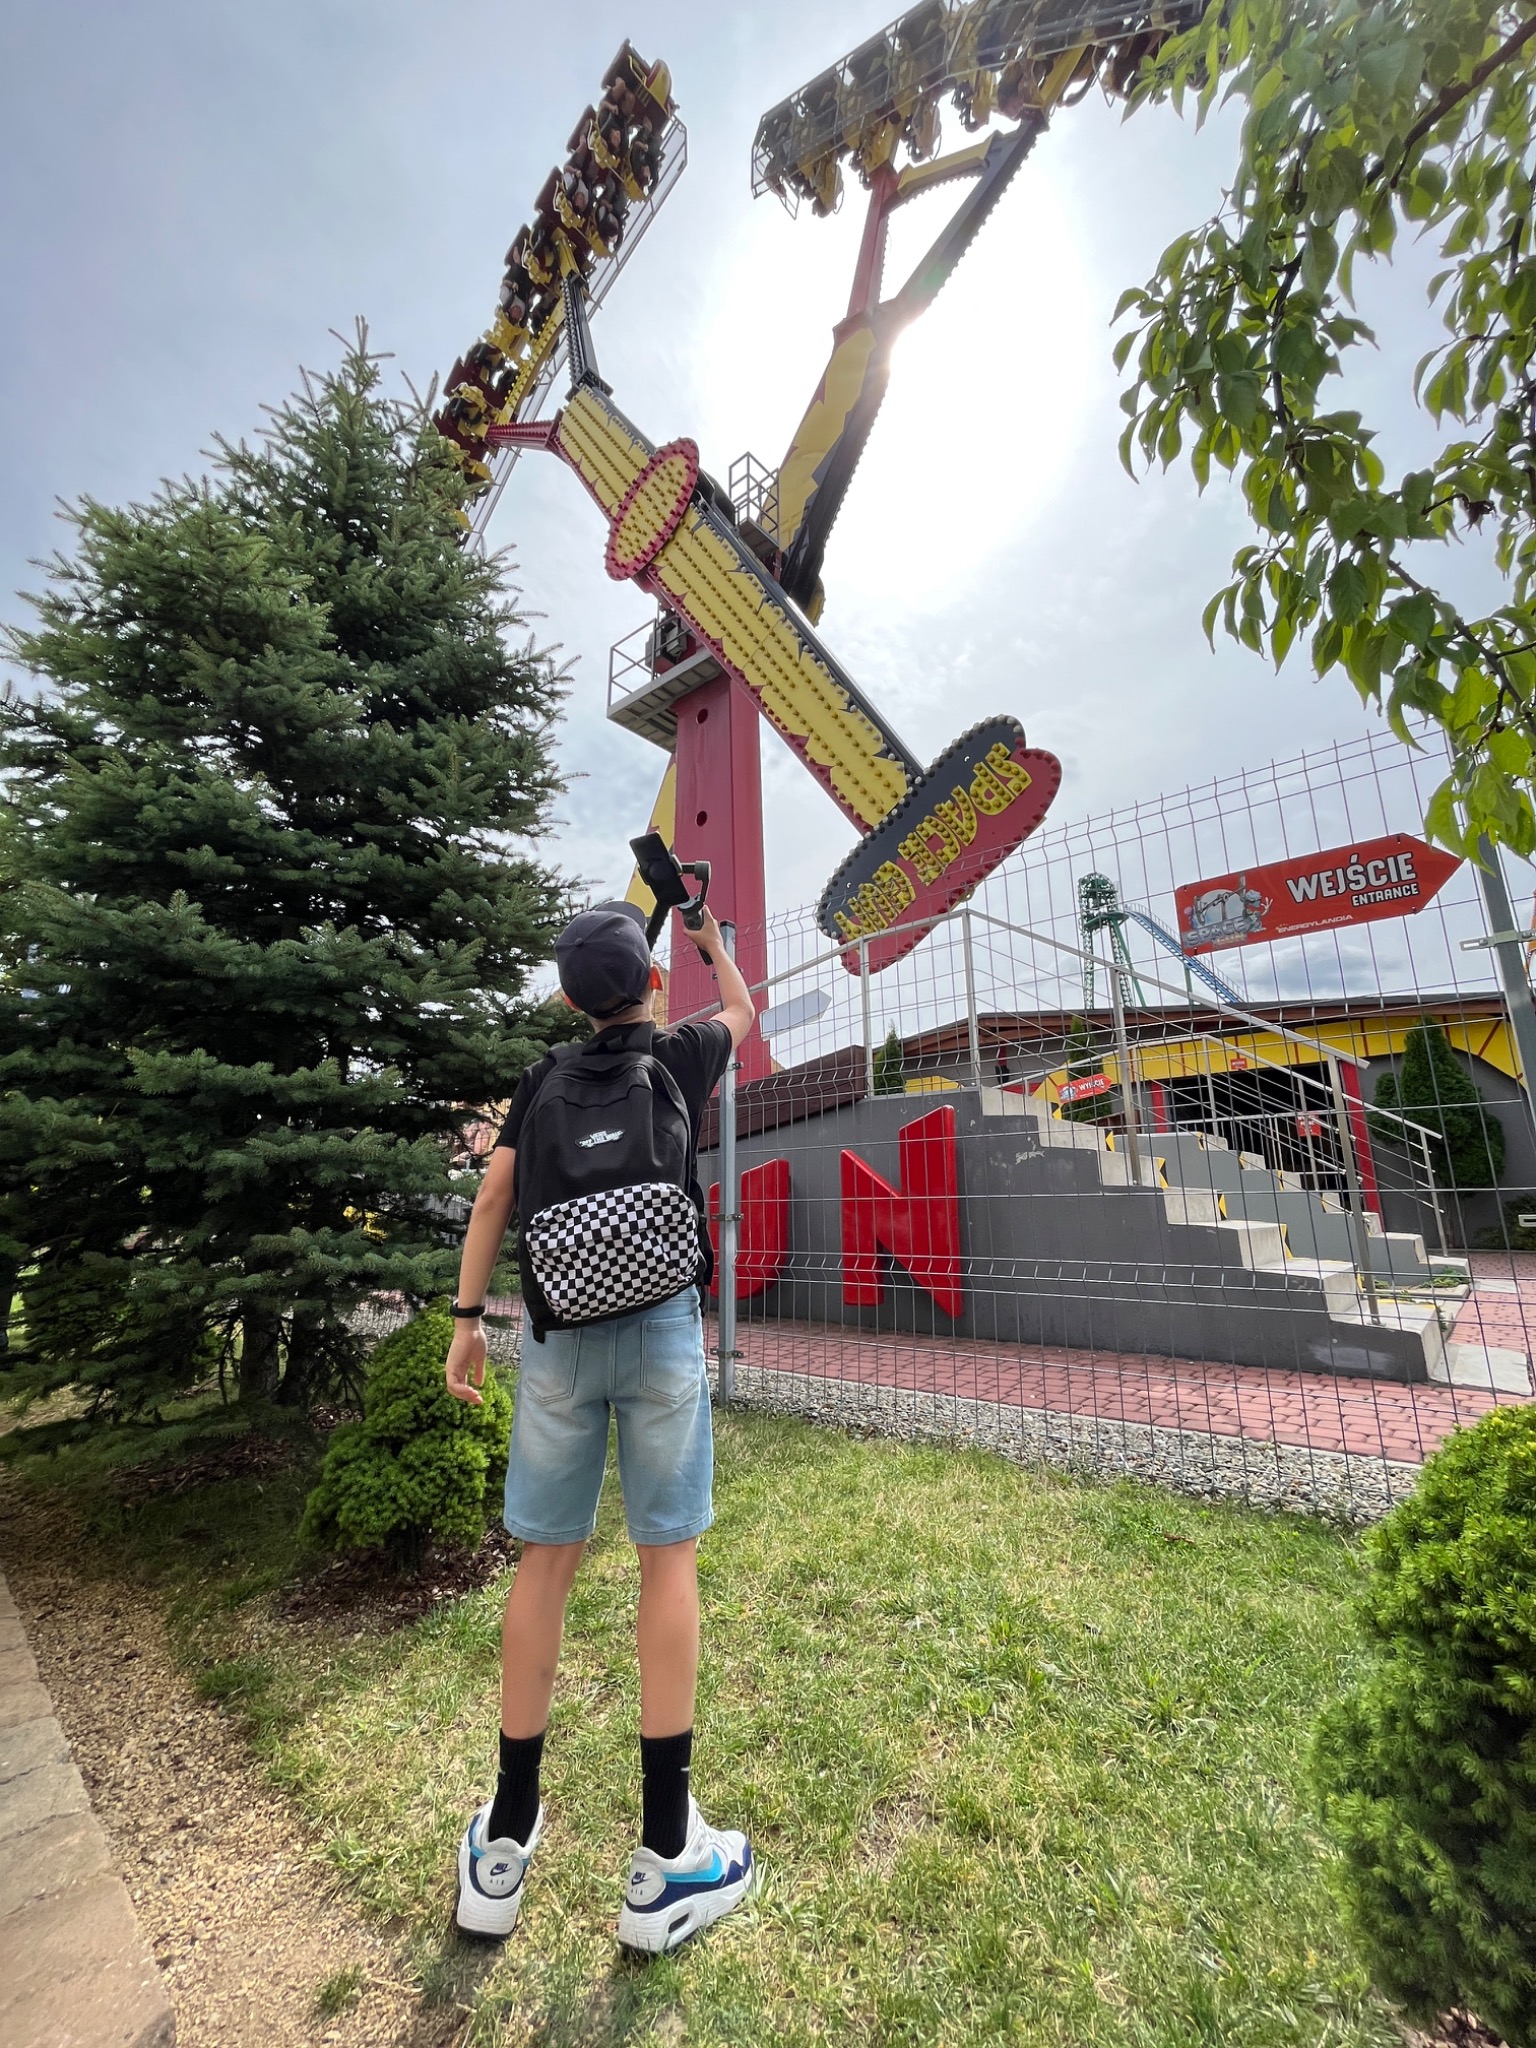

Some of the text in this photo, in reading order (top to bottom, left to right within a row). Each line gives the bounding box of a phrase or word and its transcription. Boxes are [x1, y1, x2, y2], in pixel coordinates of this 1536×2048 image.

[897, 742, 1032, 886] SPACE
[1286, 852, 1417, 903] WEJŚCIE
[1351, 882, 1420, 907] ENTRANCE
[1186, 913, 1250, 946] SPACE
